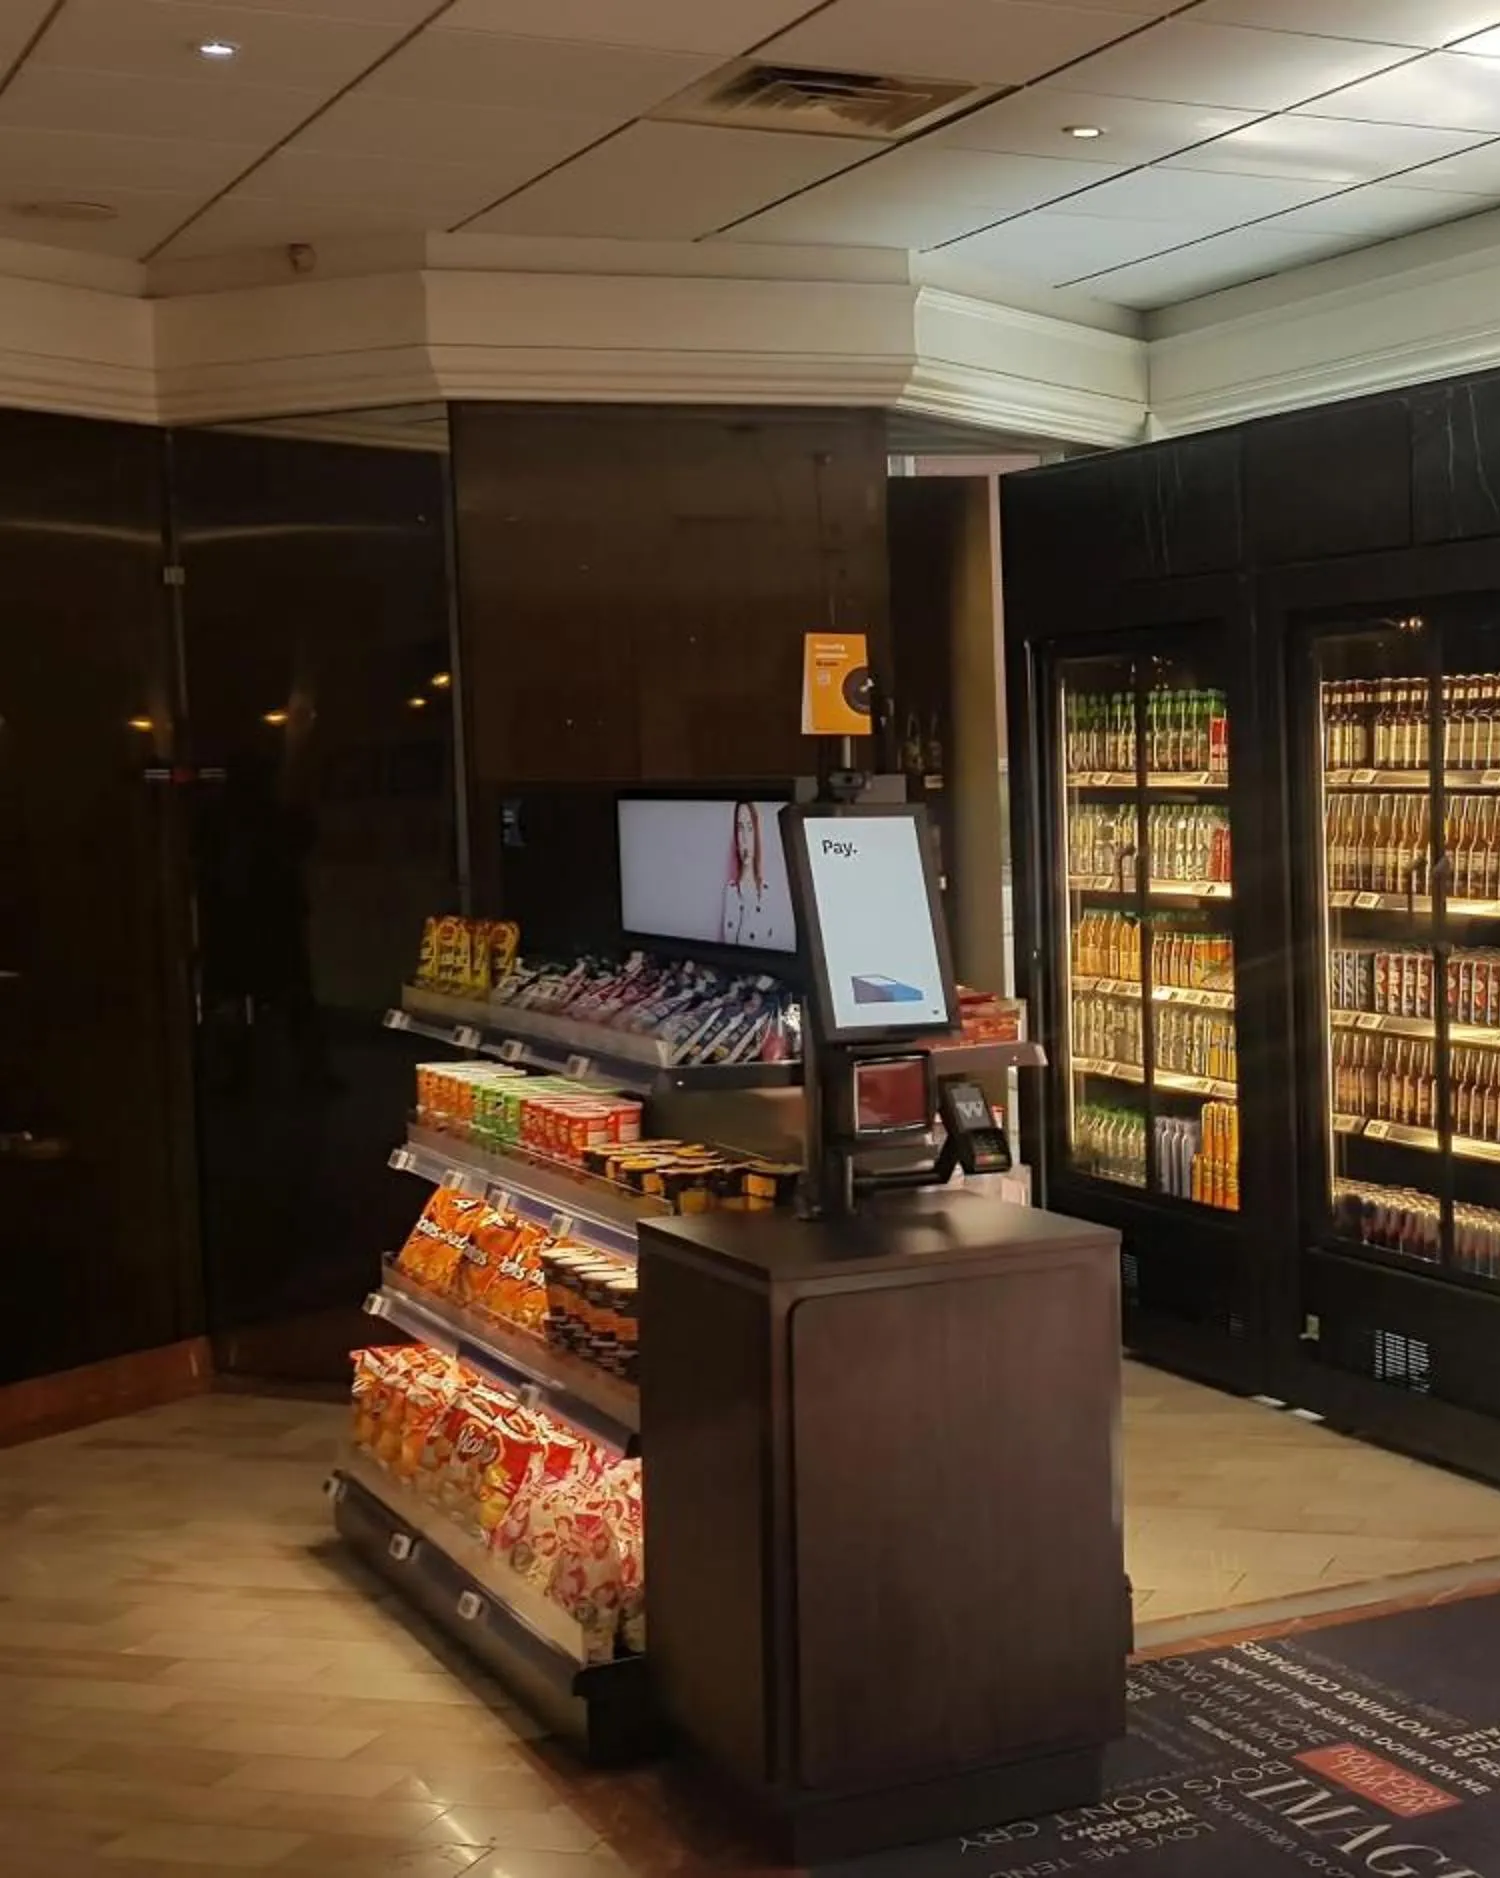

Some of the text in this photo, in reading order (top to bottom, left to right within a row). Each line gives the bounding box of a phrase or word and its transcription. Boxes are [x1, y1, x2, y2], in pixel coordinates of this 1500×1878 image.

[822, 839, 858, 857] Pay.
[1230, 1639, 1342, 1692] COMPARES
[1209, 1681, 1266, 1706] WAY
[1262, 1709, 1338, 1744] HOME
[1335, 1691, 1439, 1738] NOTHING
[1255, 1679, 1290, 1693] LET
[1314, 1708, 1353, 1725] SUN
[1348, 1725, 1377, 1737] GO
[1374, 1737, 1434, 1765] DOWN
[1429, 1764, 1463, 1779] ON
[1457, 1779, 1492, 1795] ME
[1183, 1760, 1294, 1795] BOYS
[1329, 1748, 1450, 1806] ROCK YOU
[1330, 1760, 1431, 1812] WE WILL
[1055, 1787, 1180, 1829] DON'T
[960, 1822, 1040, 1853] CRY
[1081, 1844, 1130, 1860] ME
[1131, 1821, 1217, 1849] LOVE
